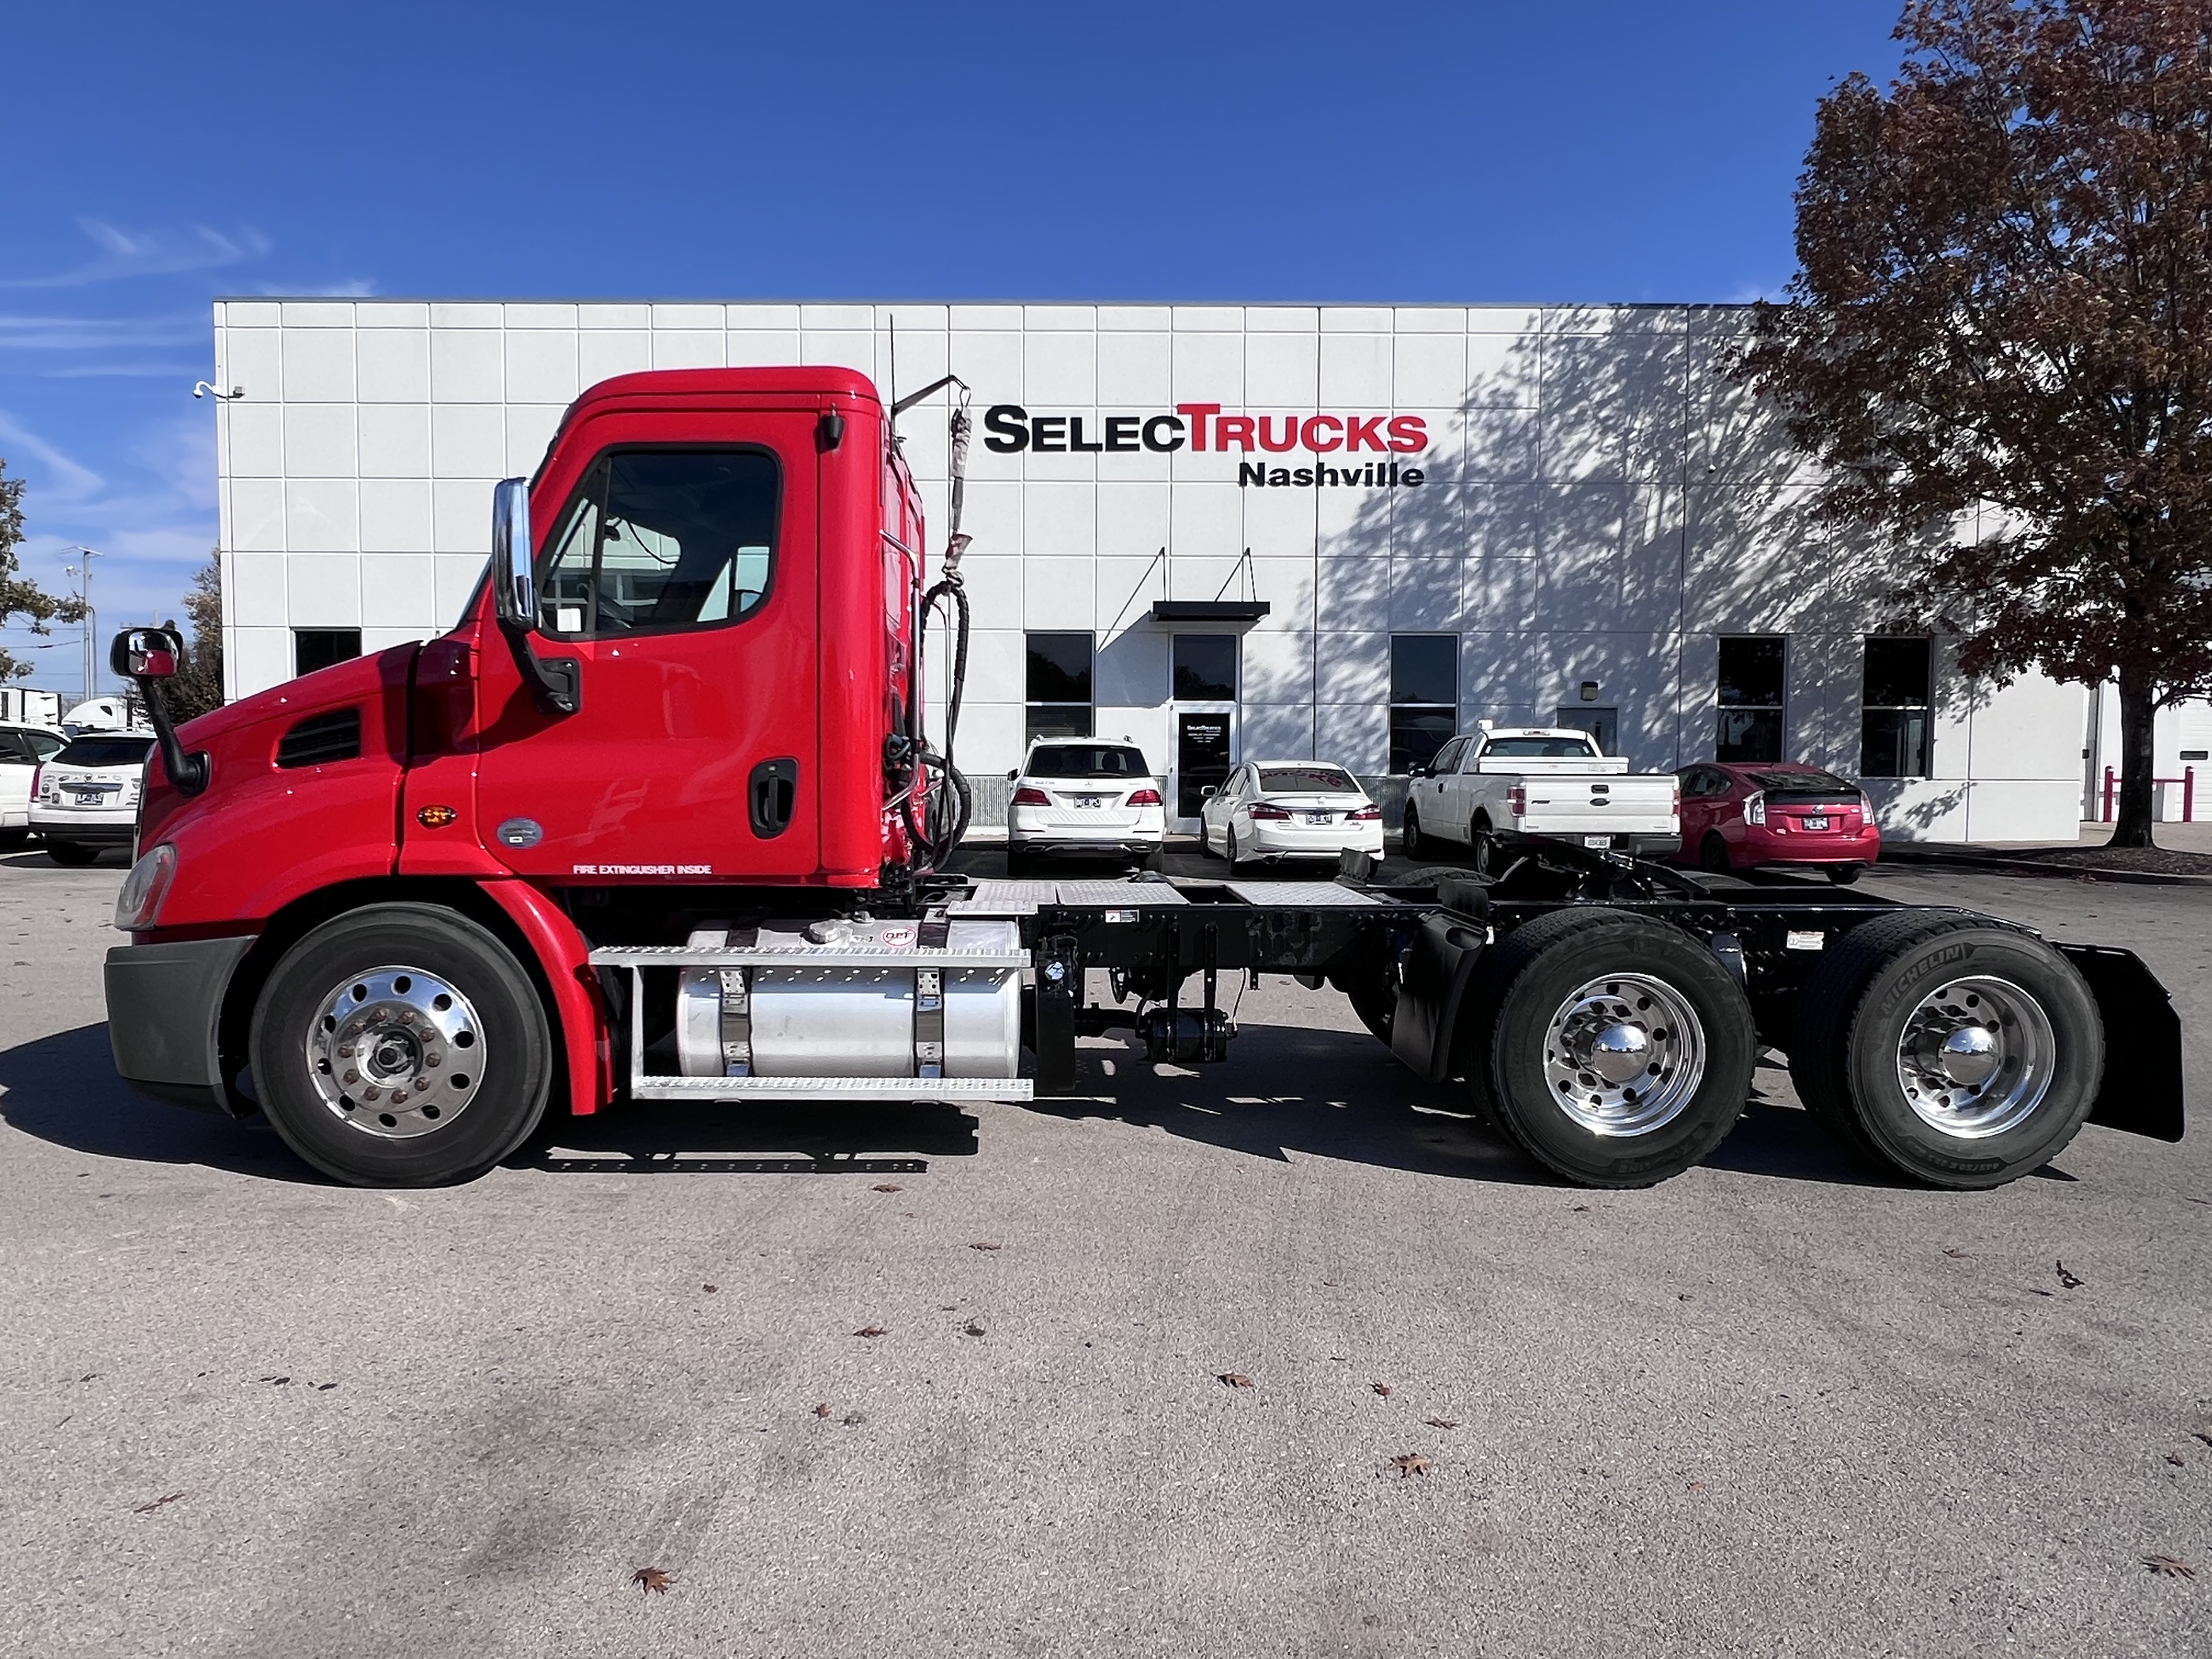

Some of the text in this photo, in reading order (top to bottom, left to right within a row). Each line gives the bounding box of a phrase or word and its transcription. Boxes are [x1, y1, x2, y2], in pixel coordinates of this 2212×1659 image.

[1239, 462, 1425, 487] Nashville
[573, 865, 712, 874] FIRE EXTINGUISHER INSIDE
[1881, 946, 1960, 1015] MICHELIN
